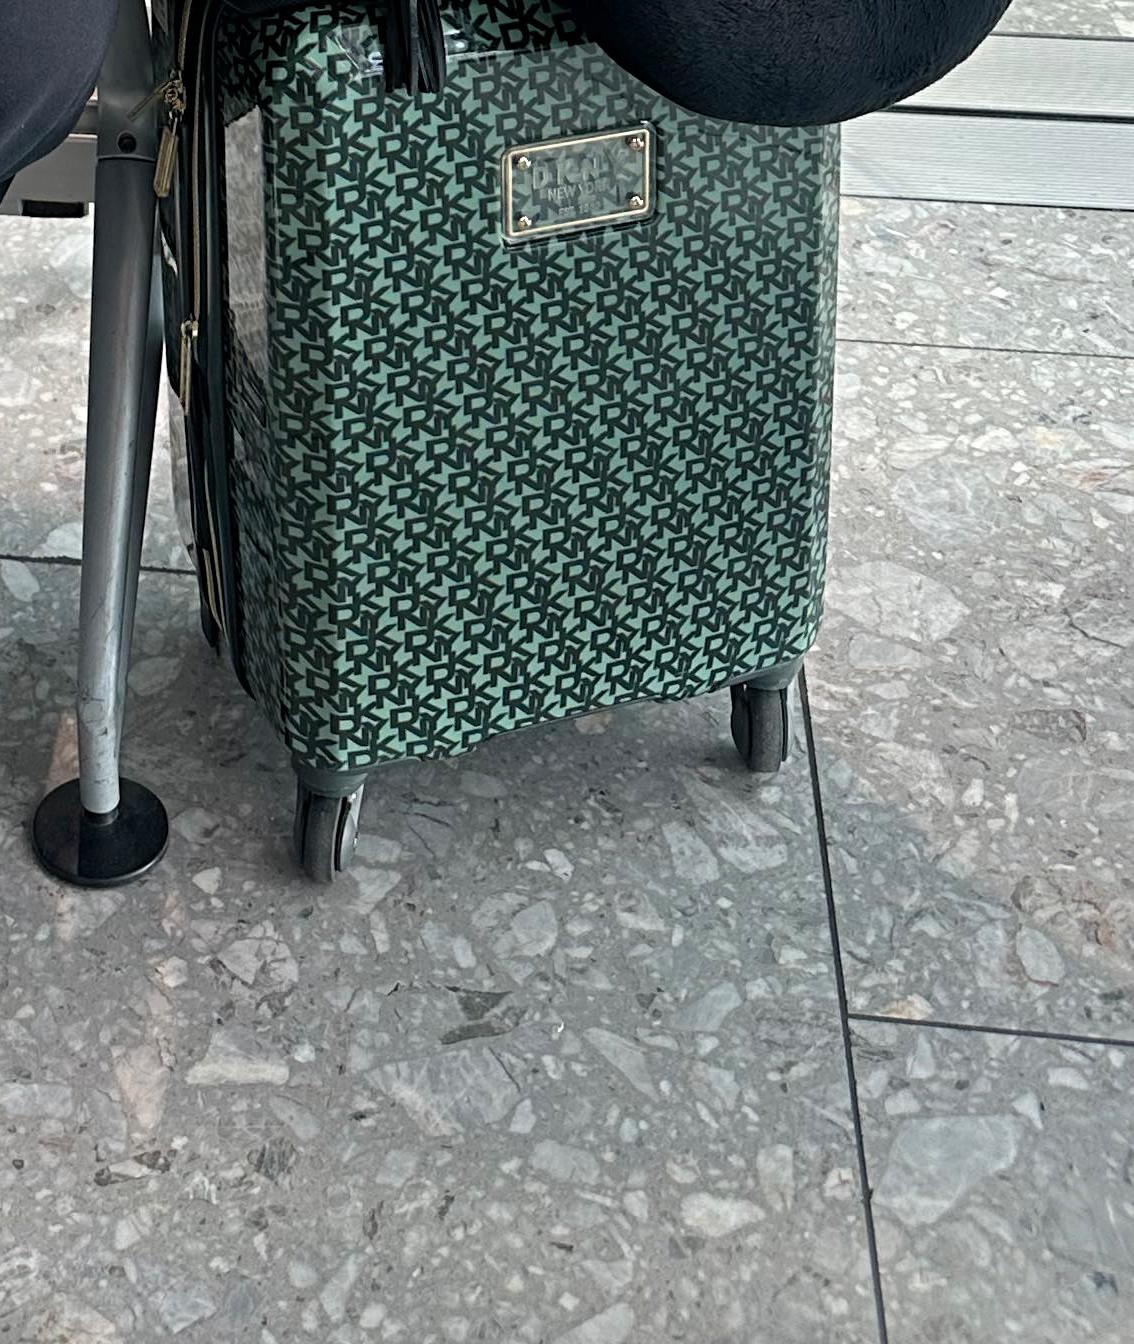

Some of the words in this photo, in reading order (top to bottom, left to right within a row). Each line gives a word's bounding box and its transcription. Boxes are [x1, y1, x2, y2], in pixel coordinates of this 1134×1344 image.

[533, 147, 622, 190] DKNY
[548, 184, 577, 202] NEW
[577, 179, 611, 198] YORK
